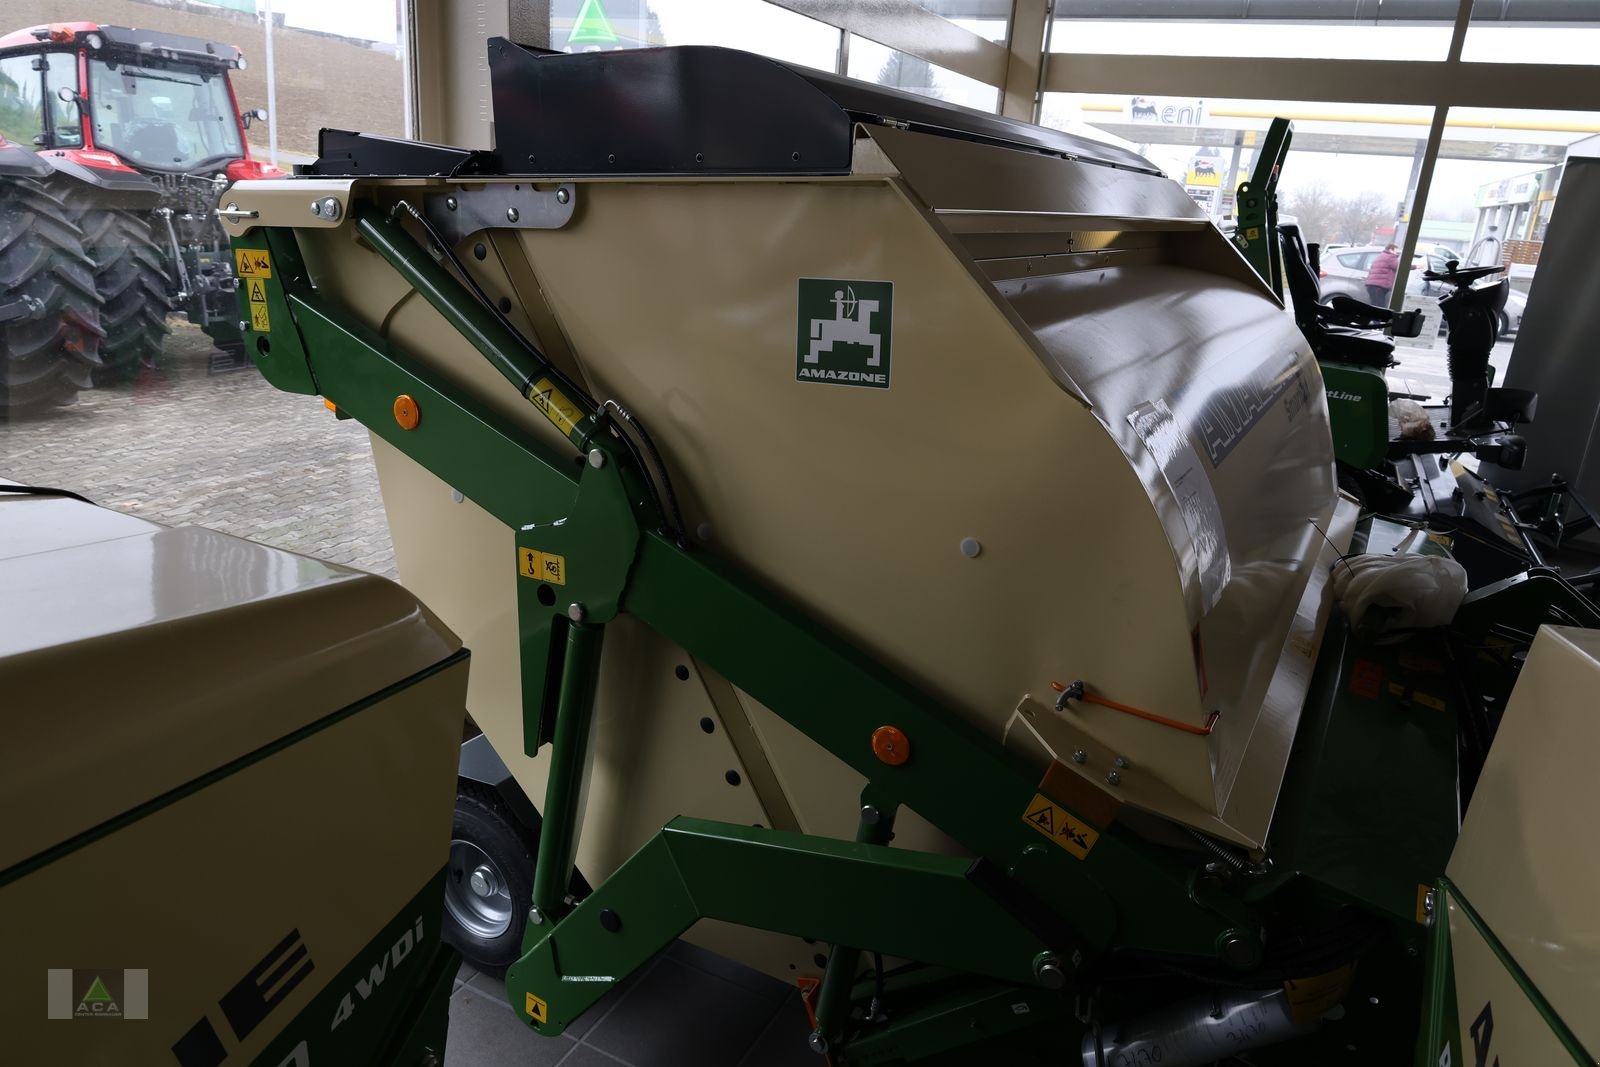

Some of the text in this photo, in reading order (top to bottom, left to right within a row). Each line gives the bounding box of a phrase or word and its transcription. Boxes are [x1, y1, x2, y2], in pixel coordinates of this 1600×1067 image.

[1161, 100, 1204, 125] eni
[798, 367, 887, 384] AMAZONE
[1325, 390, 1363, 402] tLine
[330, 914, 425, 1033] 4WDi
